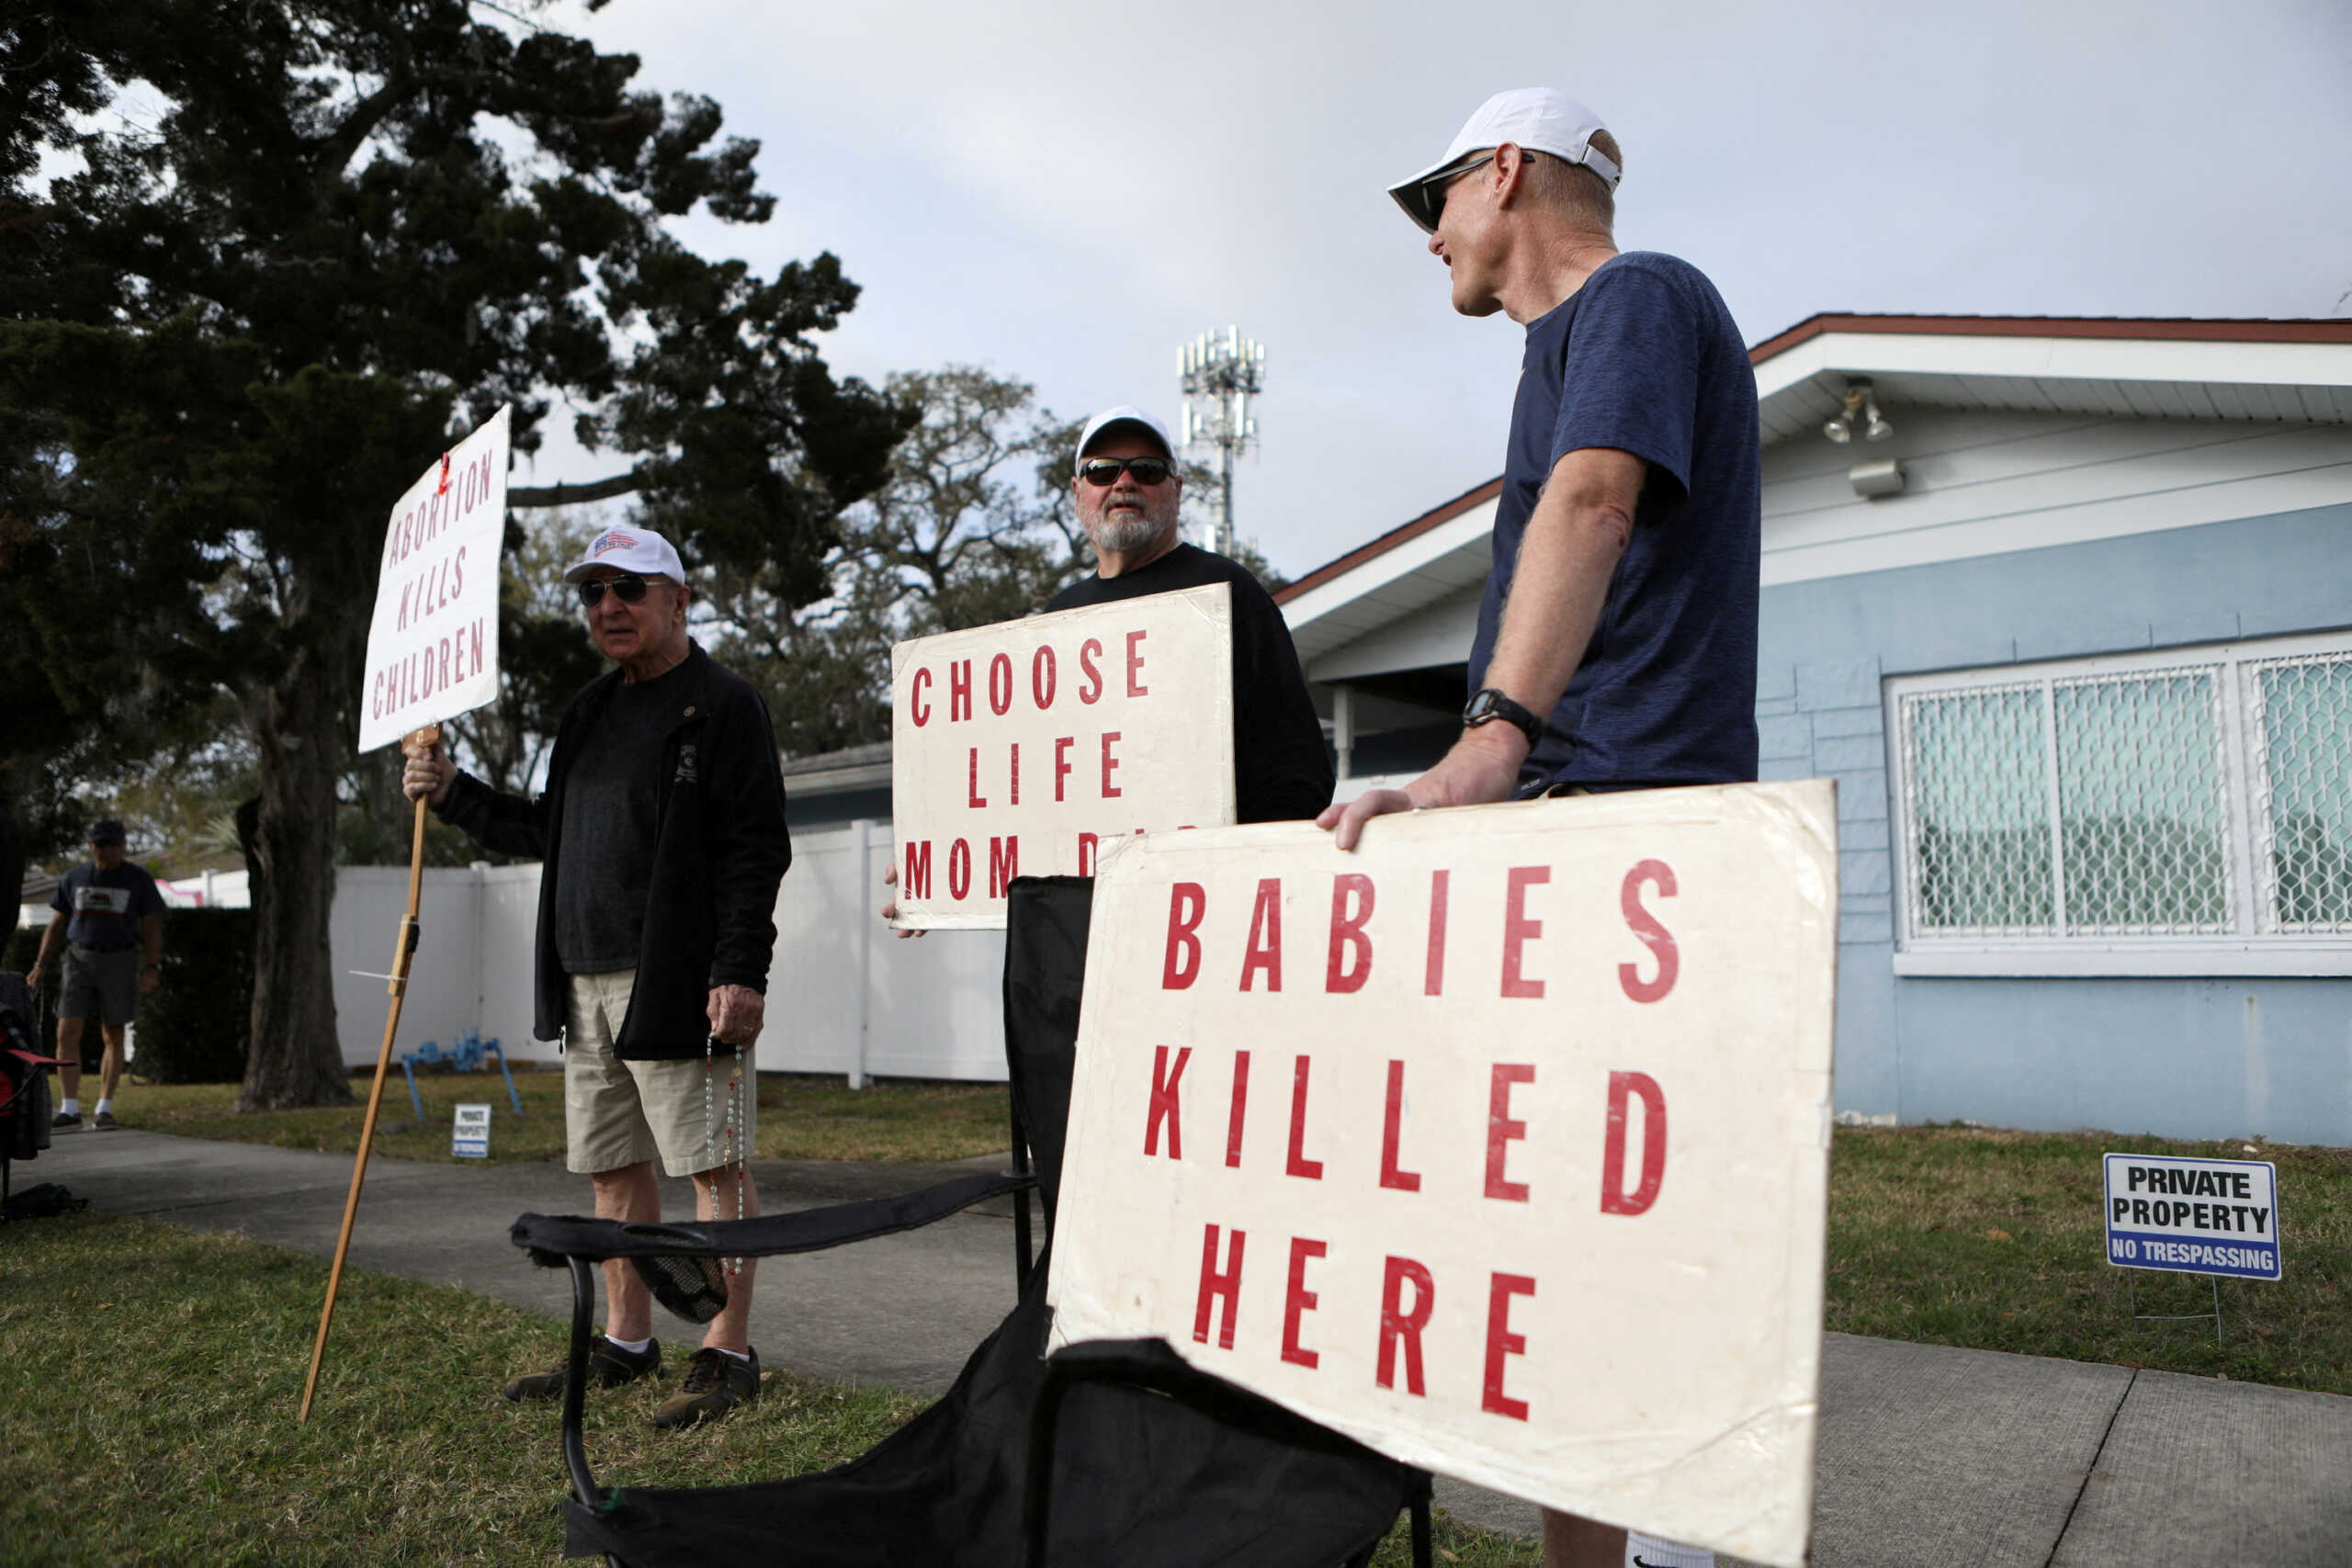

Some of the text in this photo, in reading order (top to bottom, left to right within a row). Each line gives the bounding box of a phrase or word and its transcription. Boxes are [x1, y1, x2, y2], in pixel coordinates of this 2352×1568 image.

[390, 449, 492, 569] ABORTION
[397, 547, 467, 633] KILLS
[373, 617, 484, 720] CHILDREN
[911, 629, 1148, 728] CHOOSE
[968, 731, 1122, 808] LIFE
[905, 835, 1019, 900] MOM
[1161, 859, 1679, 1005] BABIES
[1144, 1044, 1668, 1217] KILLED
[2113, 1198, 2268, 1234] PROPERTY
[2128, 1167, 2251, 1199] PRIVATE
[2111, 1238, 2274, 1271] NO TRESPASSING
[1192, 1223, 1537, 1423] HERE
